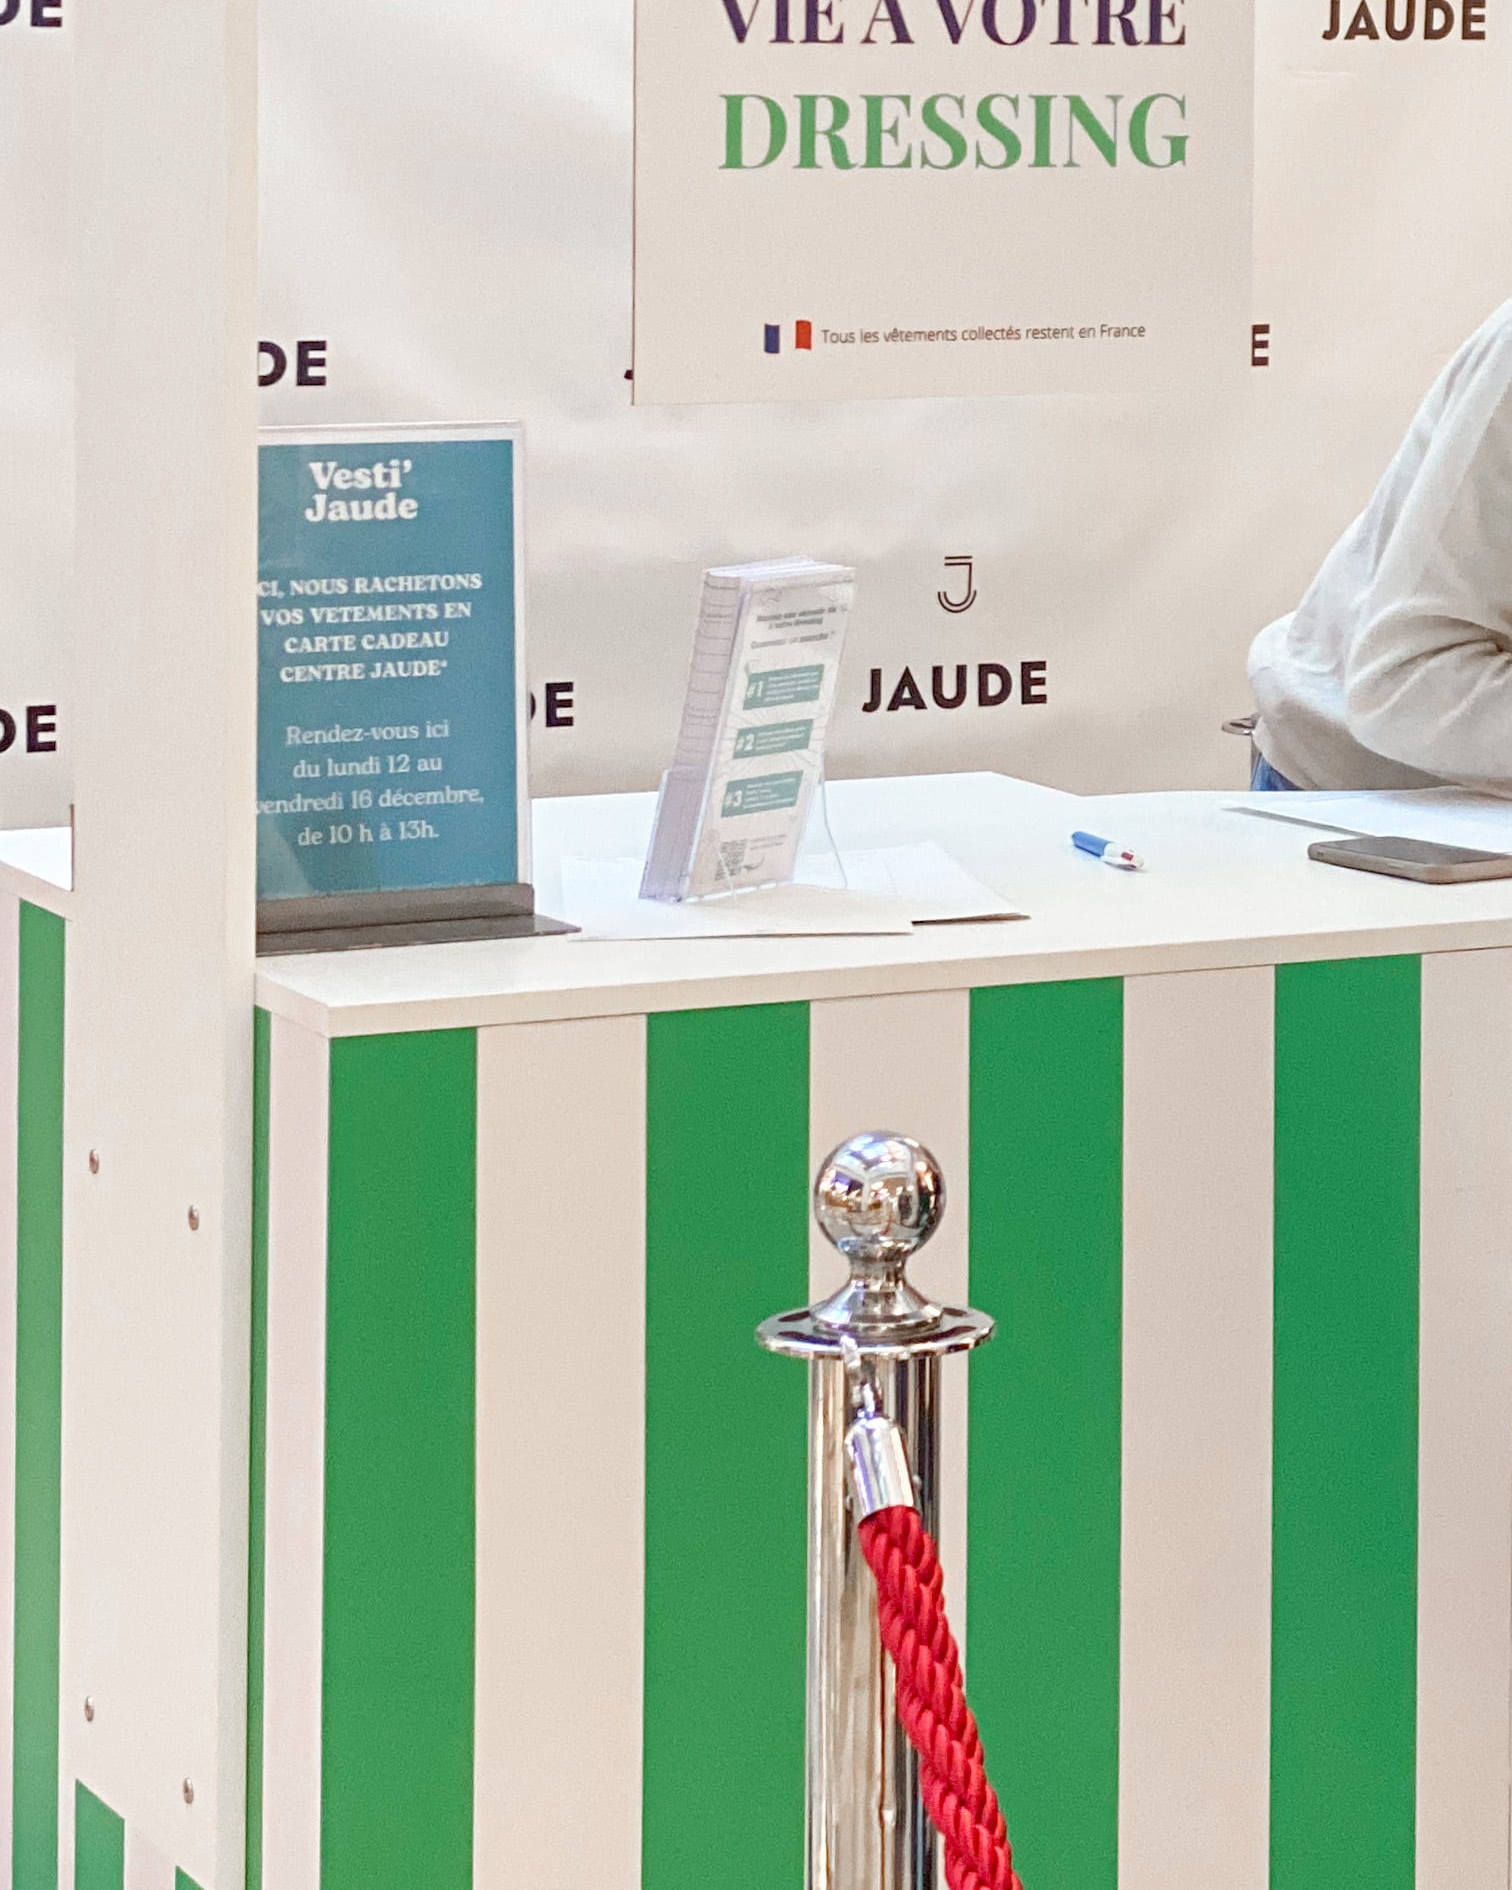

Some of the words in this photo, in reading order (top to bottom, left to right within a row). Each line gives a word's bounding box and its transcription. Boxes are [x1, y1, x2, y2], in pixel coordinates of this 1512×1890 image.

[719, 94, 1188, 170] DRESSING
[821, 329, 855, 343] Tous
[860, 327, 880, 343] les
[884, 328, 957, 342] vêtements
[962, 326, 1021, 341] collectés
[1026, 327, 1074, 339] restent
[1079, 328, 1095, 338] en
[1100, 324, 1145, 338] France
[305, 492, 418, 522] Jaude
[256, 580, 285, 599] CI,
[290, 578, 348, 595] NOUS
[354, 573, 482, 593] RACHETONS
[261, 609, 303, 625] VOS
[310, 604, 438, 623] VETEMENTS
[444, 602, 471, 618] EN
[284, 635, 356, 653] CARTE
[361, 631, 448, 650] CADEAU
[280, 663, 365, 682] CENTRE
[862, 661, 1047, 712] JAUDE
[286, 724, 419, 745] Rendez-vous
[426, 720, 449, 738] ici
[293, 760, 320, 778] du
[328, 756, 381, 776] lundi
[388, 754, 410, 773] 12
[418, 758, 442, 771] au
[352, 790, 372, 809] 16
[379, 785, 484, 807] décembre,
[298, 827, 322, 845] de
[330, 824, 352, 844] 10
[360, 824, 373, 842] h
